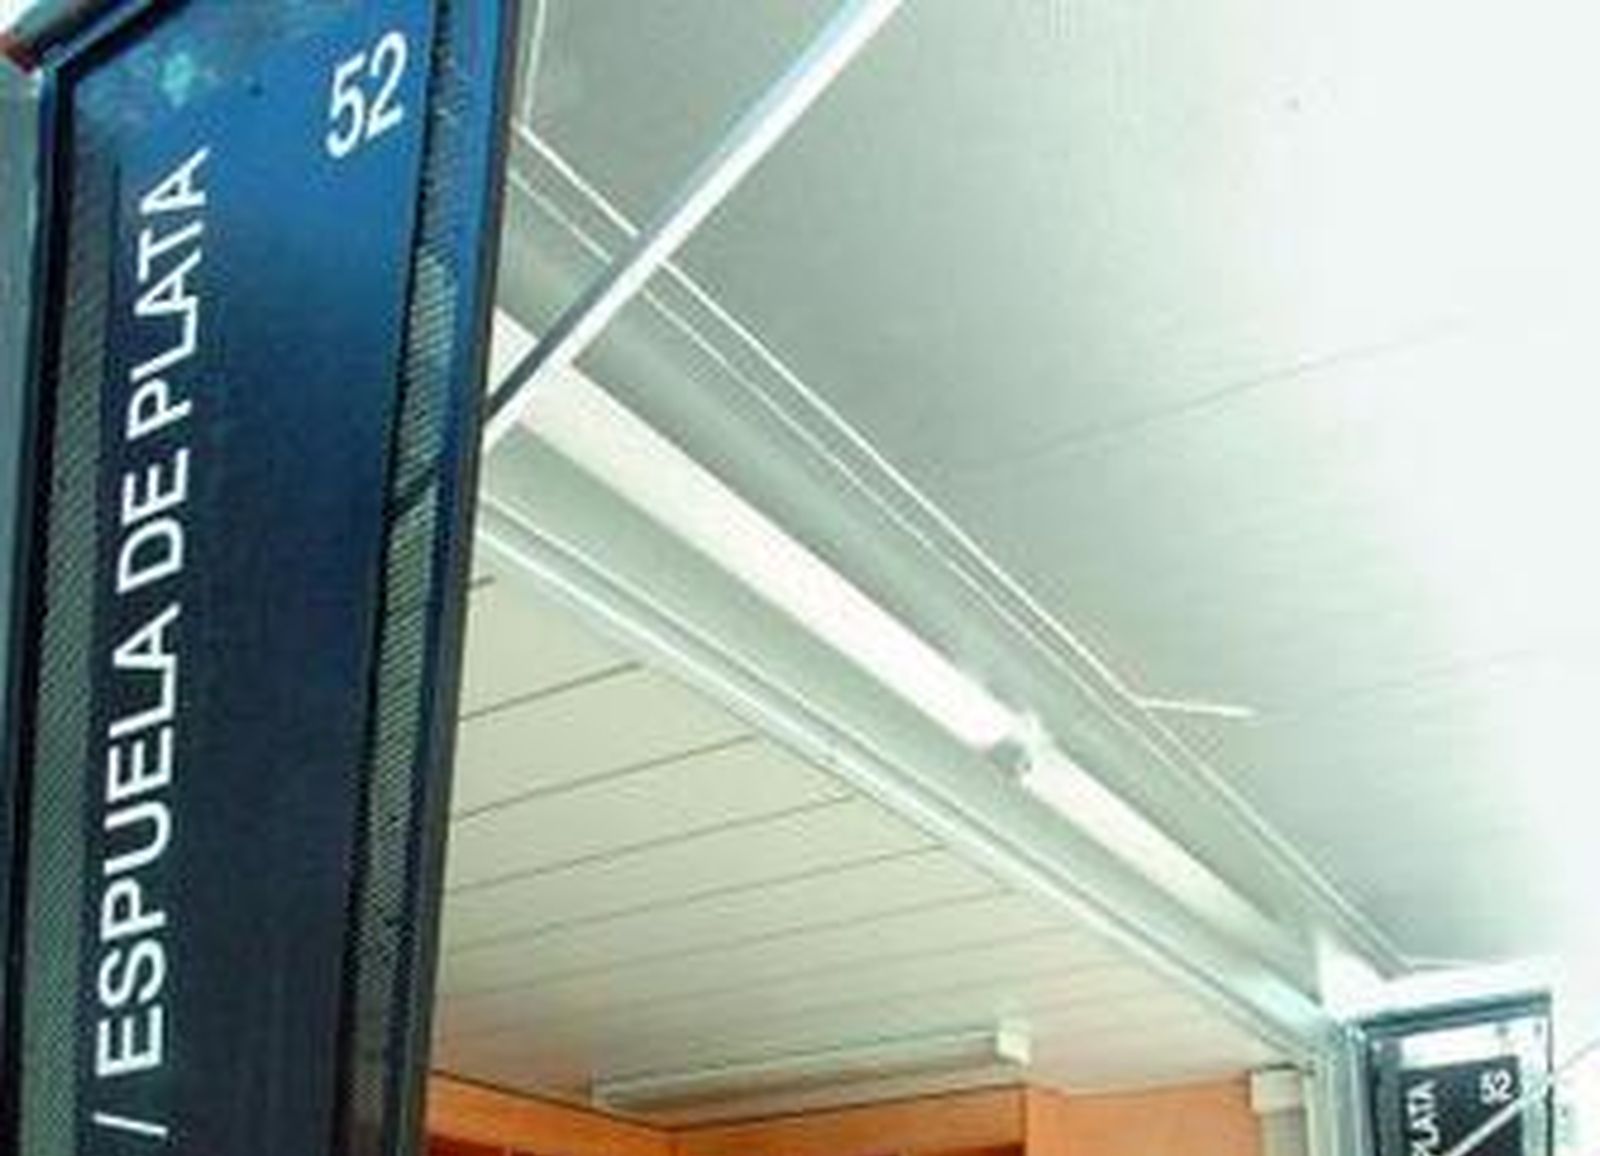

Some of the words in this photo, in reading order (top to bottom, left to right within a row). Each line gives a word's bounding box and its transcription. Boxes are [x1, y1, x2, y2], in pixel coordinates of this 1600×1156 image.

[325, 30, 408, 159] 52
[130, 146, 211, 440] PLATA
[116, 448, 191, 593] DE
[95, 604, 181, 1077] ESPUELA
[93, 1112, 169, 1136] /
[1480, 1069, 1512, 1104] 52
